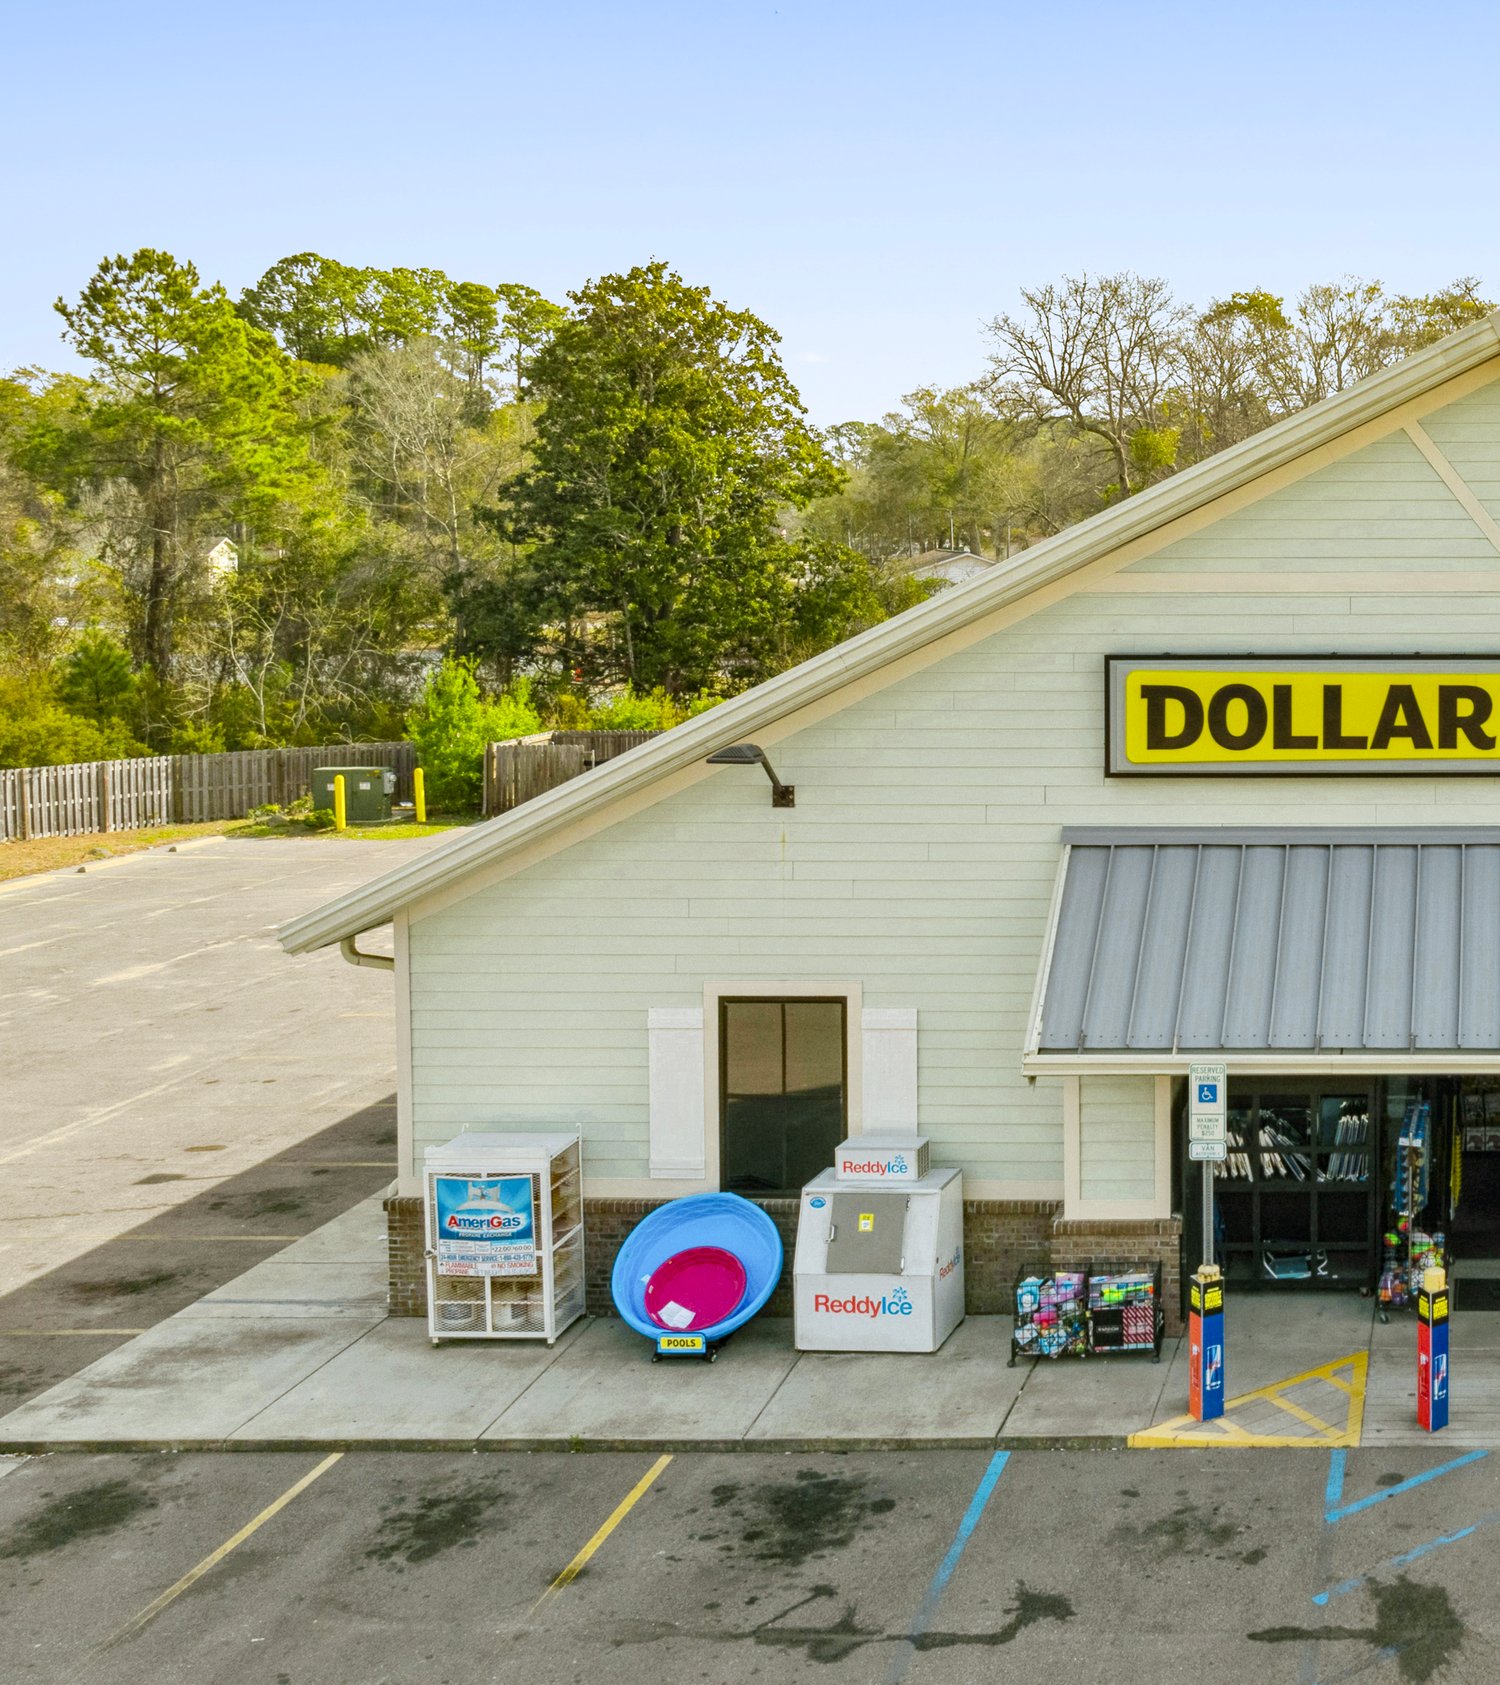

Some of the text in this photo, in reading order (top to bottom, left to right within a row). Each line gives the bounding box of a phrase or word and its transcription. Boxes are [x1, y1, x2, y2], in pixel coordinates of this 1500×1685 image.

[1140, 683, 1497, 751] DOLLAR
[447, 1215, 521, 1229] AmeriGas
[667, 1339, 696, 1347] POOLS
